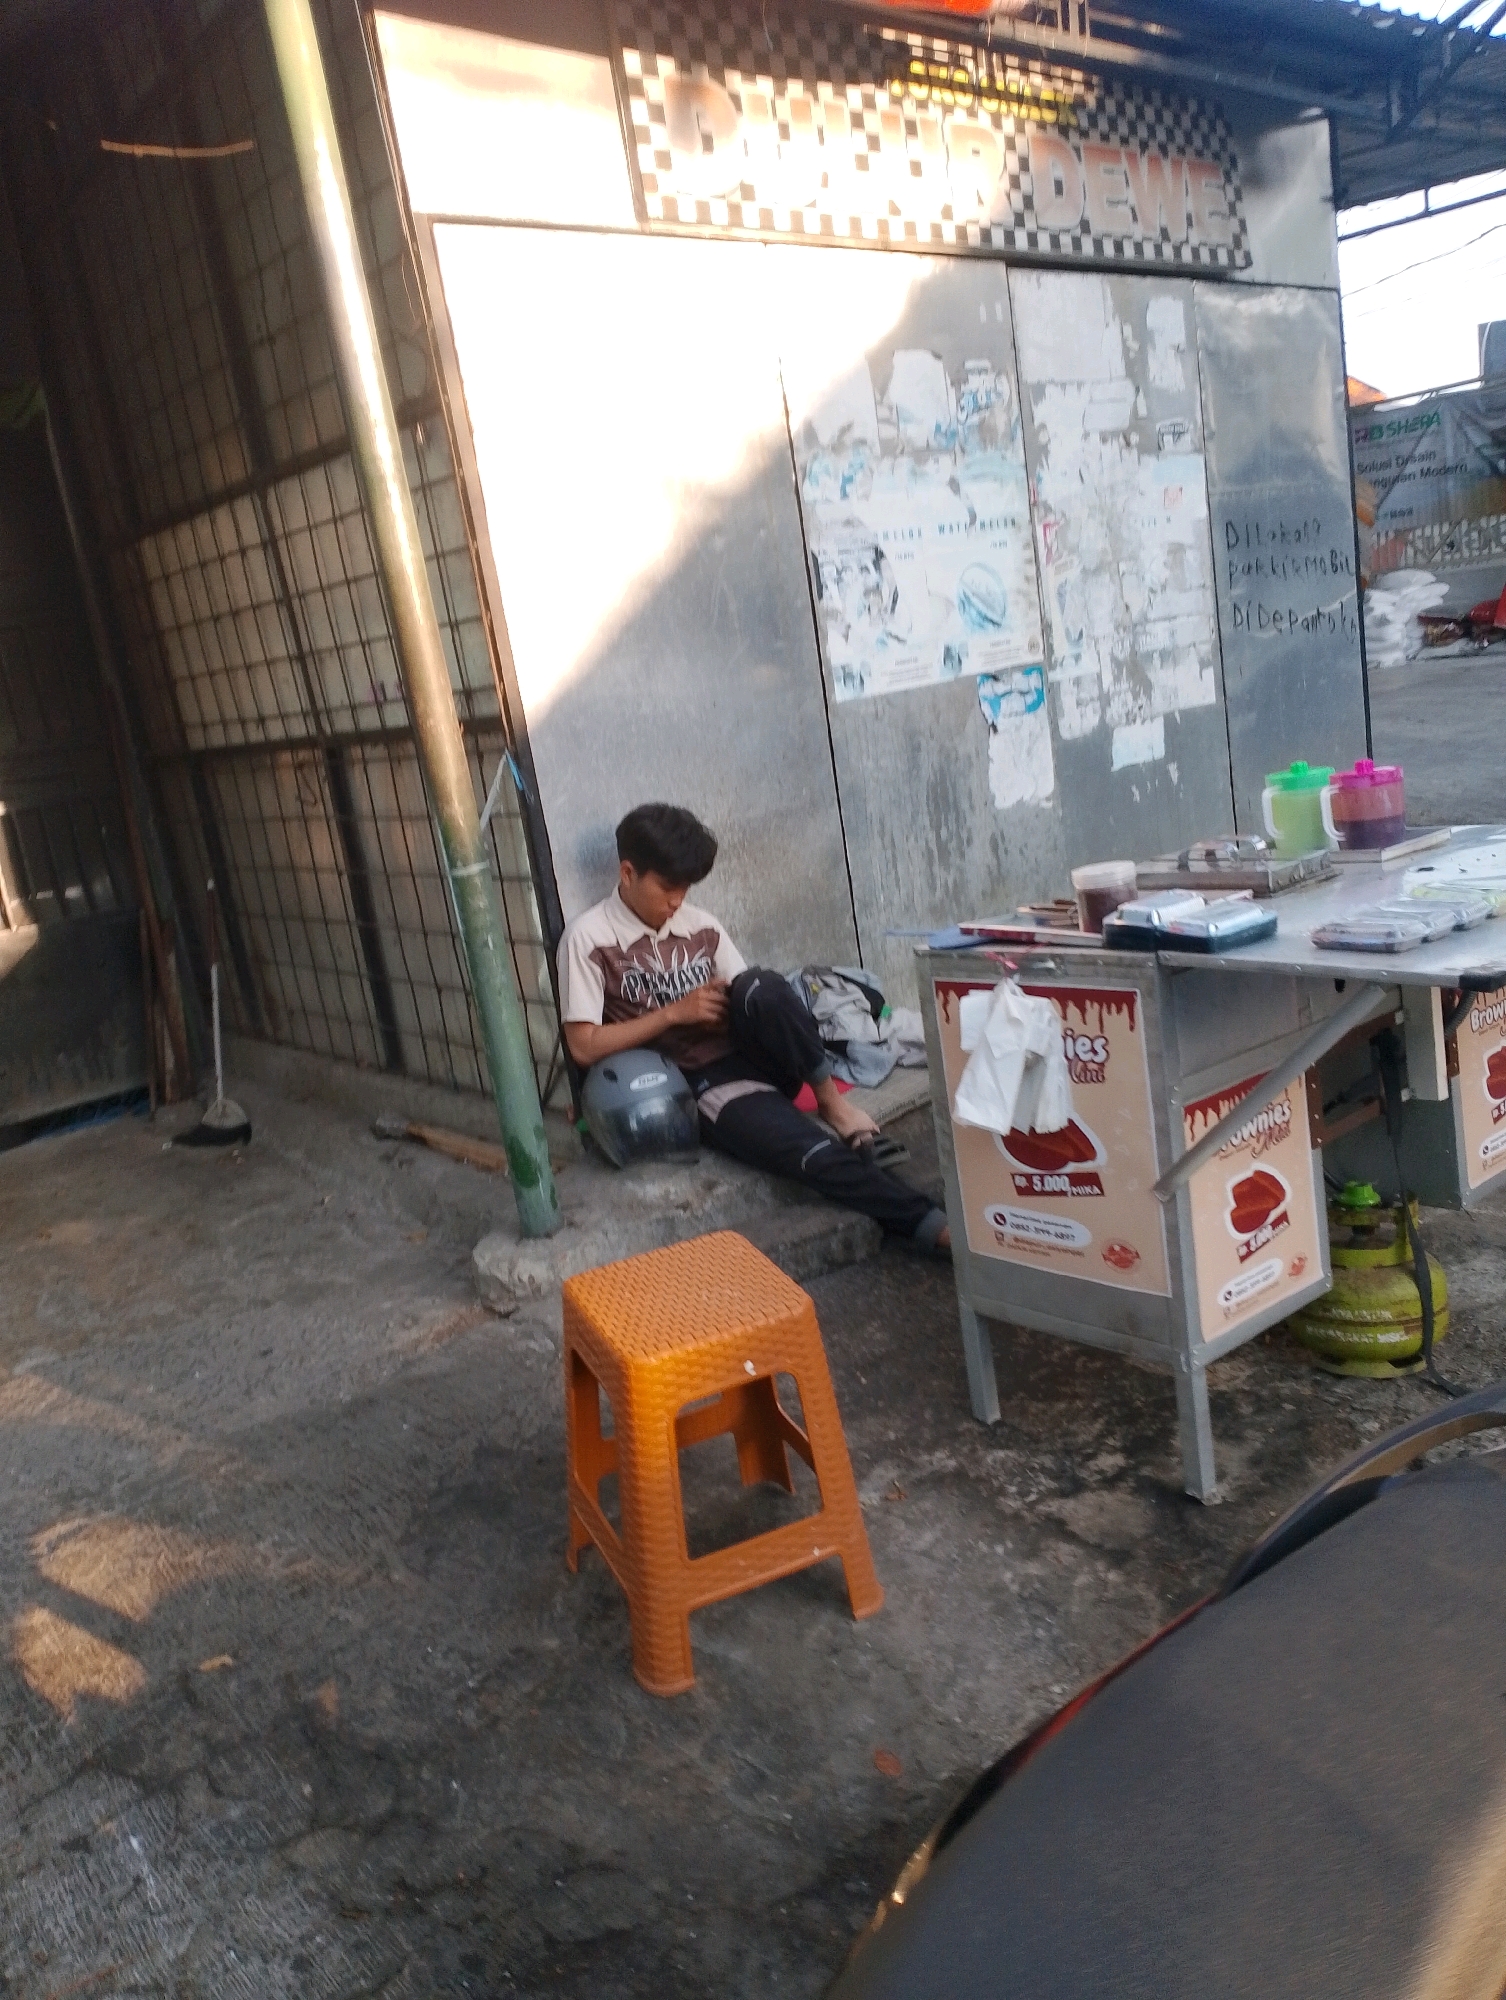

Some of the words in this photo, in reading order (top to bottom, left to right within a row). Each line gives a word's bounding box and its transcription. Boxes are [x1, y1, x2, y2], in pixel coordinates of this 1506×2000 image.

[1029, 133, 1236, 246] DEWE
[1386, 410, 1441, 437] SHERA
[937, 516, 1016, 535] WATMELON
[1062, 1027, 1110, 1064] ies
[1220, 1100, 1292, 1152] ownies
